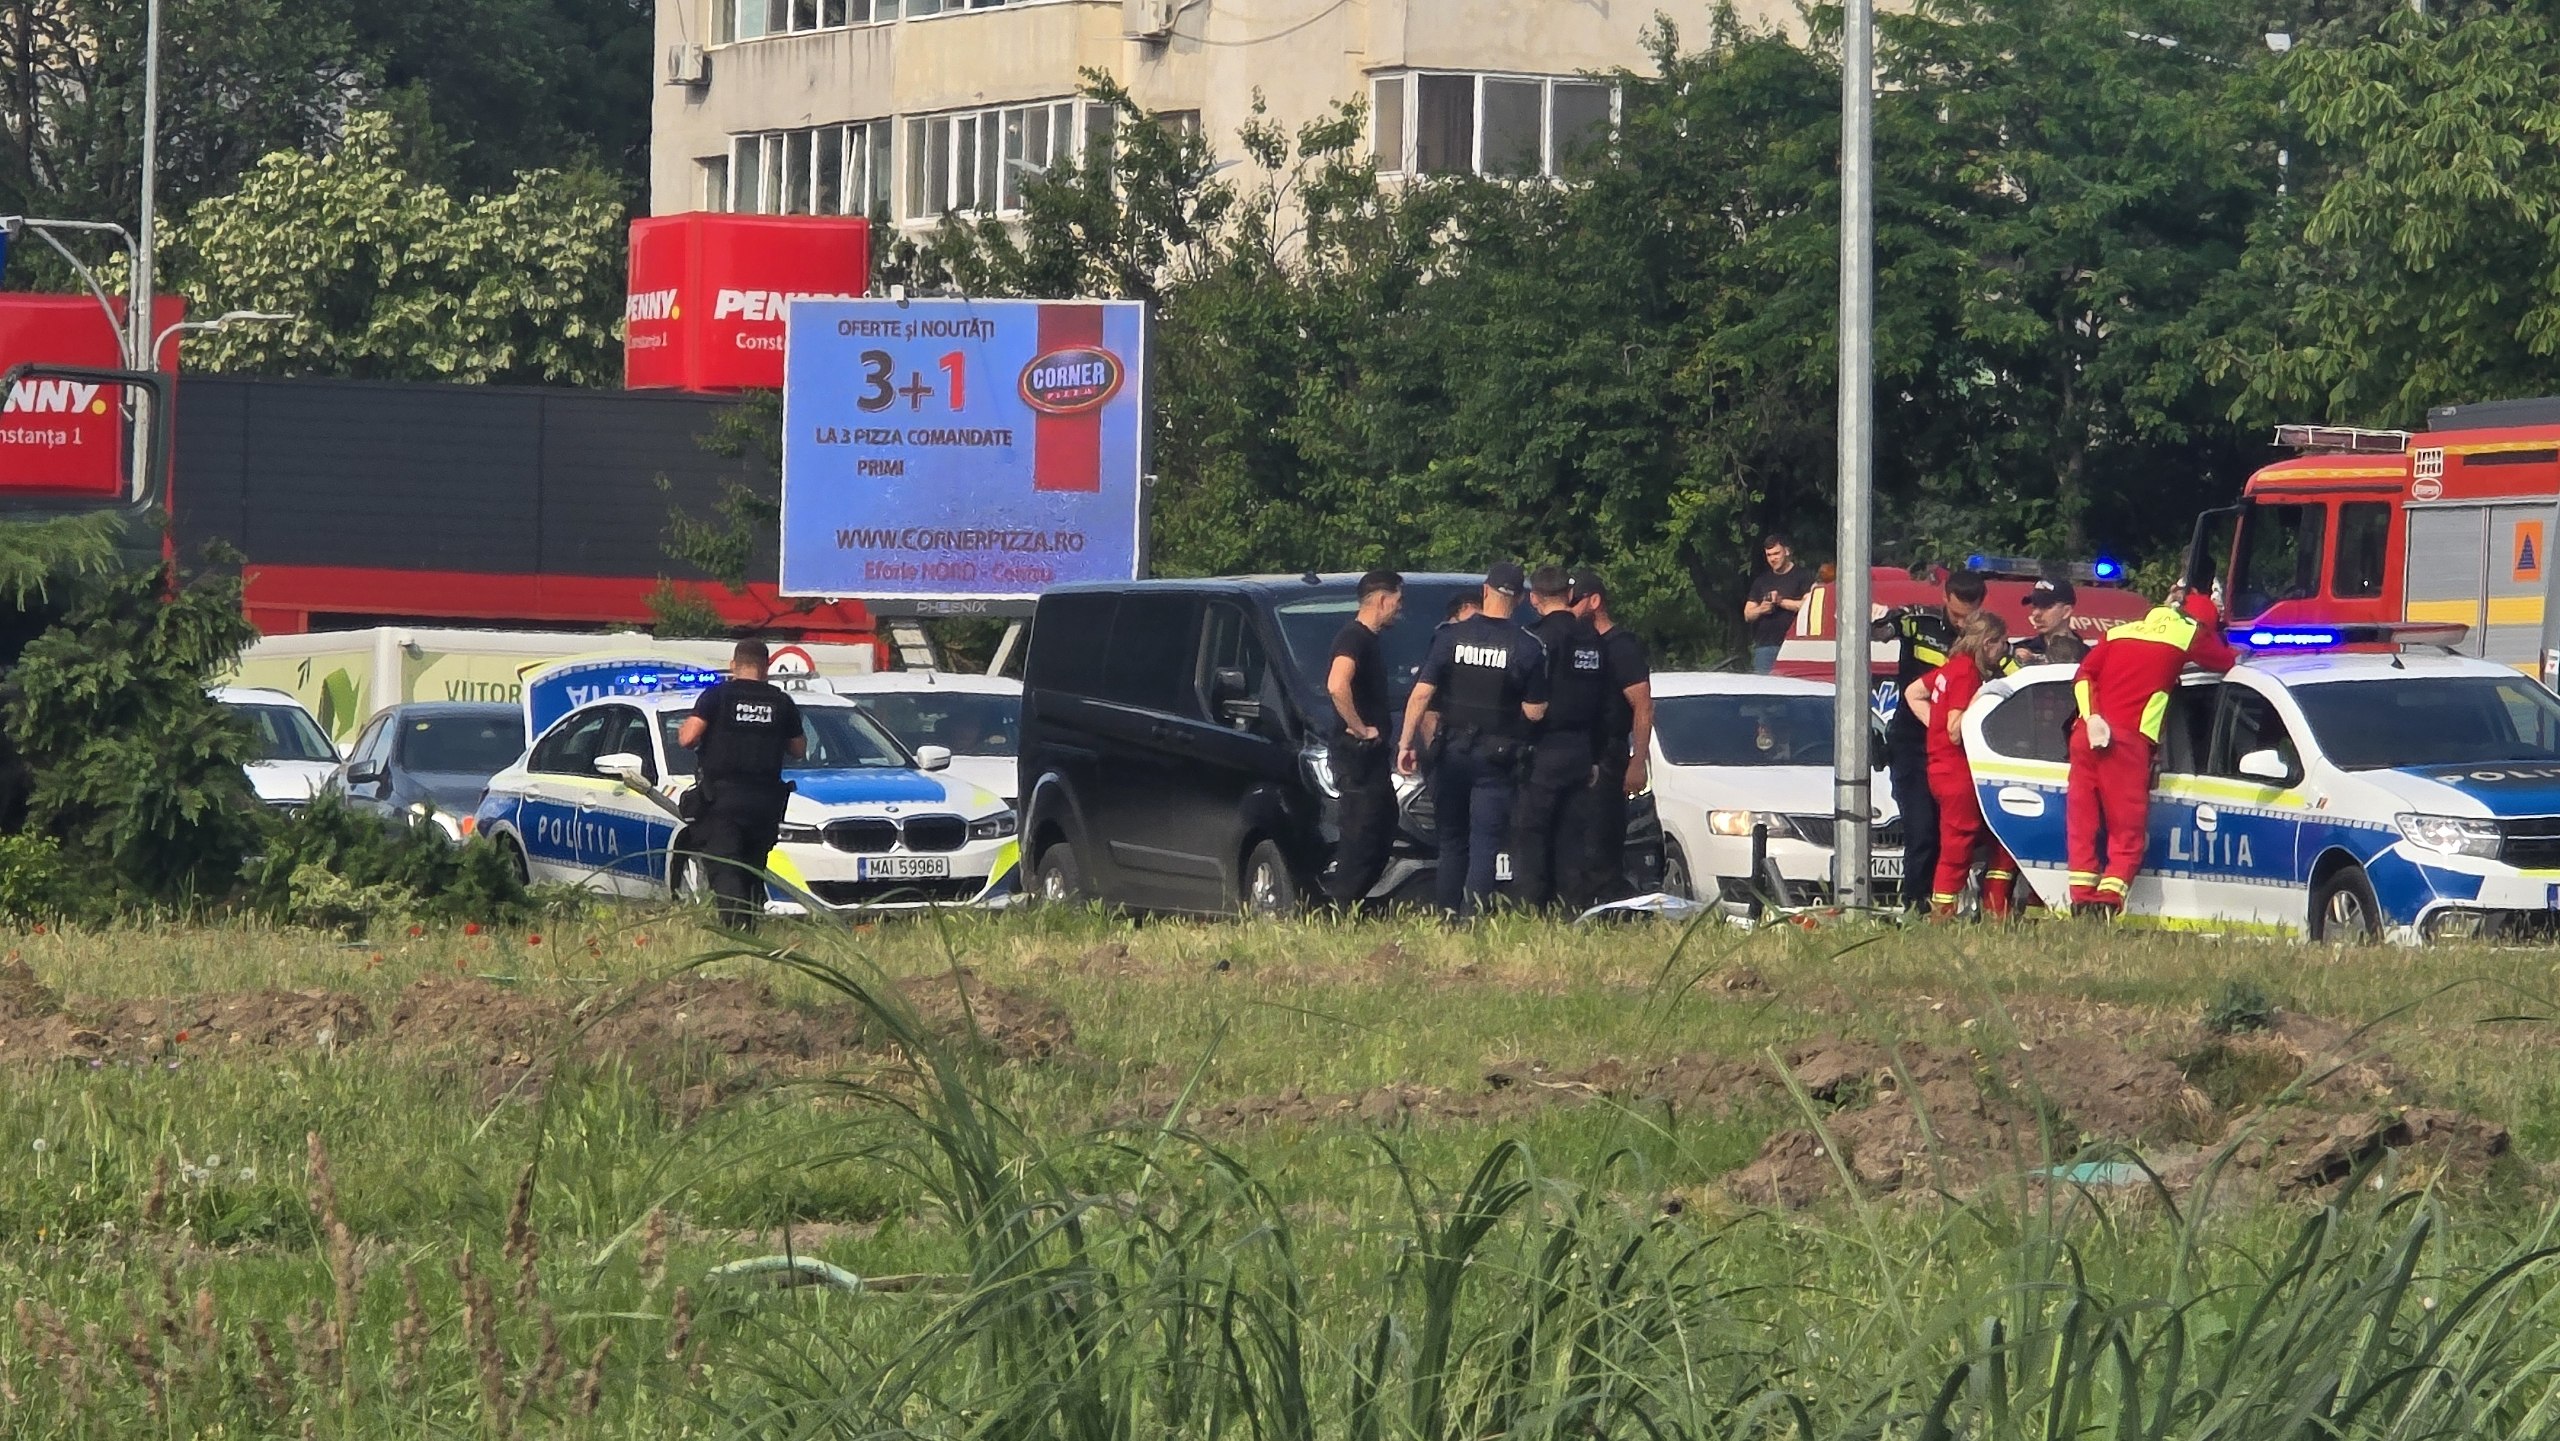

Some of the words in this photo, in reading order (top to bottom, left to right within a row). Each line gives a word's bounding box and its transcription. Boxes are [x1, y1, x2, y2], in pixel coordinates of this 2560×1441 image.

[838, 319, 901, 338] OFERTE
[736, 332, 785, 350] Const
[856, 349, 967, 413] 3+1
[1032, 361, 1105, 390] CORNER
[3, 380, 107, 415] NNY.
[72, 427, 83, 445] 1
[816, 427, 838, 445] LA
[840, 428, 852, 444] 3
[854, 428, 904, 446] PIZZA
[906, 428, 1014, 447] COMANDATE
[856, 459, 905, 477] PRIMI
[2169, 827, 2253, 868] LITIA
[870, 859, 894, 876] MAI
[899, 859, 944, 876] 59968
